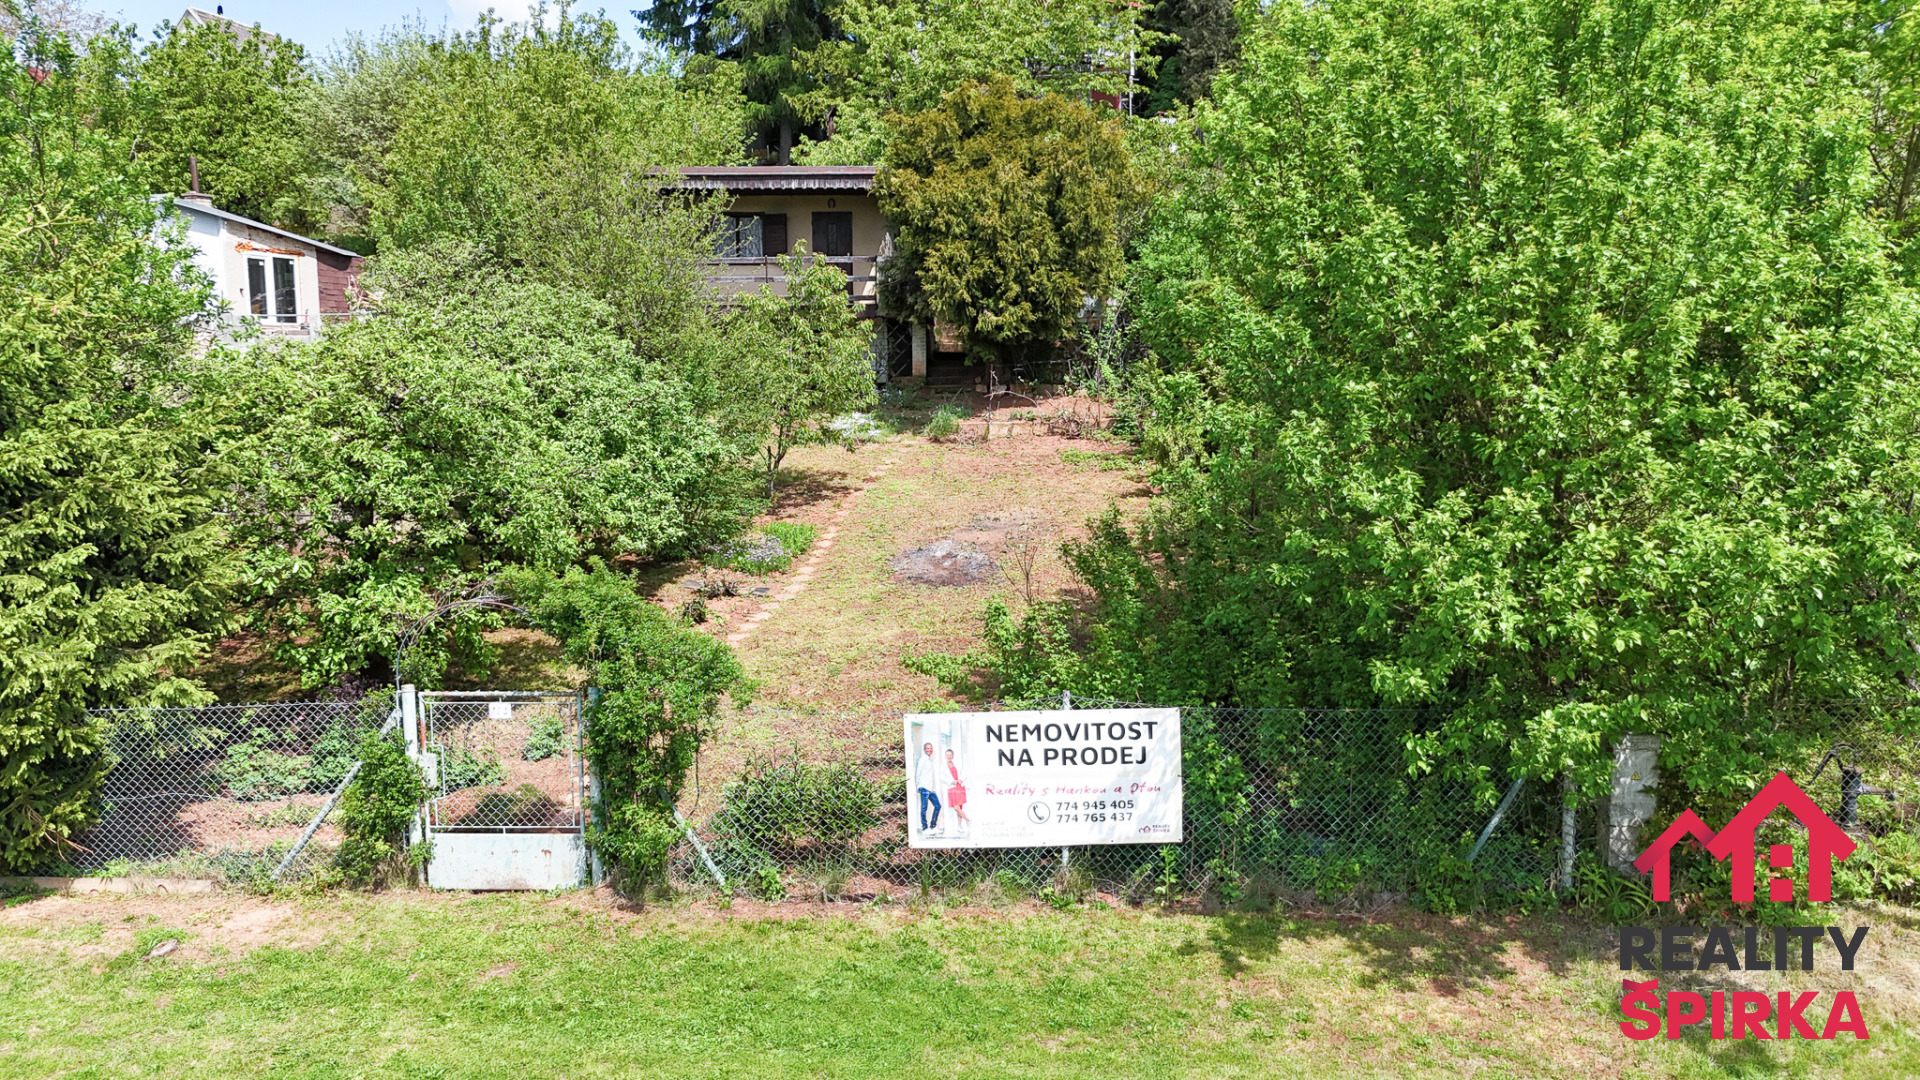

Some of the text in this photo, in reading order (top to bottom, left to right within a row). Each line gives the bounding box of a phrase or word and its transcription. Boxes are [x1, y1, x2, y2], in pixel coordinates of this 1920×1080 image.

[986, 721, 1158, 743] NEMOVITOST
[998, 746, 1147, 767] NA PRODEJ
[985, 782, 1036, 797] Reality
[1041, 787, 1049, 796] s
[1056, 785, 1106, 795] Hankou
[1113, 786, 1122, 794] a
[1056, 800, 1134, 811] 774 945 405
[1056, 812, 1133, 823] 774 765 437
